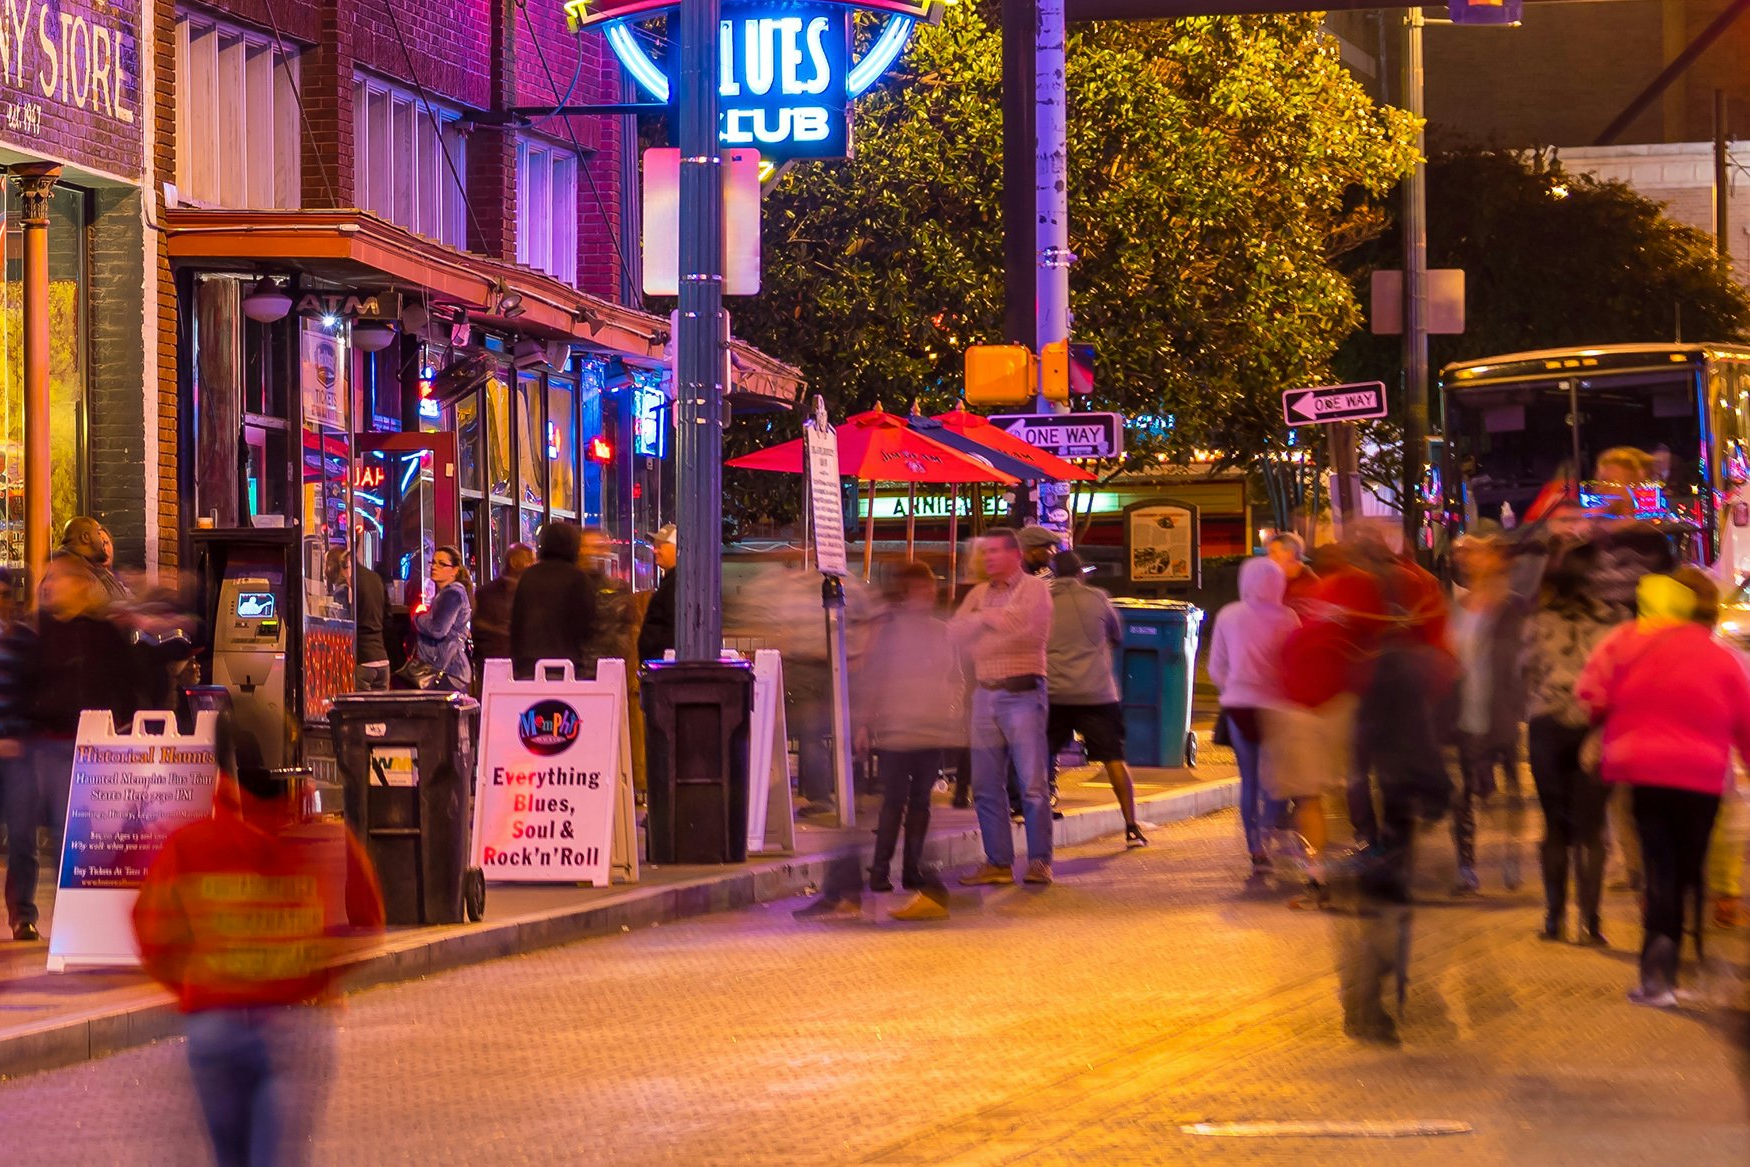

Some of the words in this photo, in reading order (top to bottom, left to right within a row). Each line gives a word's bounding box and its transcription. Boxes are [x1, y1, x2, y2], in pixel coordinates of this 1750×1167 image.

[39, 3, 135, 125] STORE
[720, 17, 830, 97] LUES
[720, 107, 830, 143] LUB
[296, 295, 380, 314] ATM
[1346, 393, 1373, 407] WAY
[1026, 429, 1059, 445] ONE
[1066, 427, 1101, 444] WAY
[518, 709, 583, 740] Memphis
[77, 746, 155, 765] Historical
[159, 747, 216, 765] Haunts
[76, 772, 119, 785] Haunted
[122, 772, 167, 788] Memphis
[190, 773, 214, 785] Tour
[493, 766, 600, 790] Everything
[91, 790, 122, 801] Starts
[514, 793, 576, 817] Blues,
[512, 819, 555, 840] Soul
[560, 822, 574, 839] &
[483, 846, 600, 867] Rock'n'Roll
